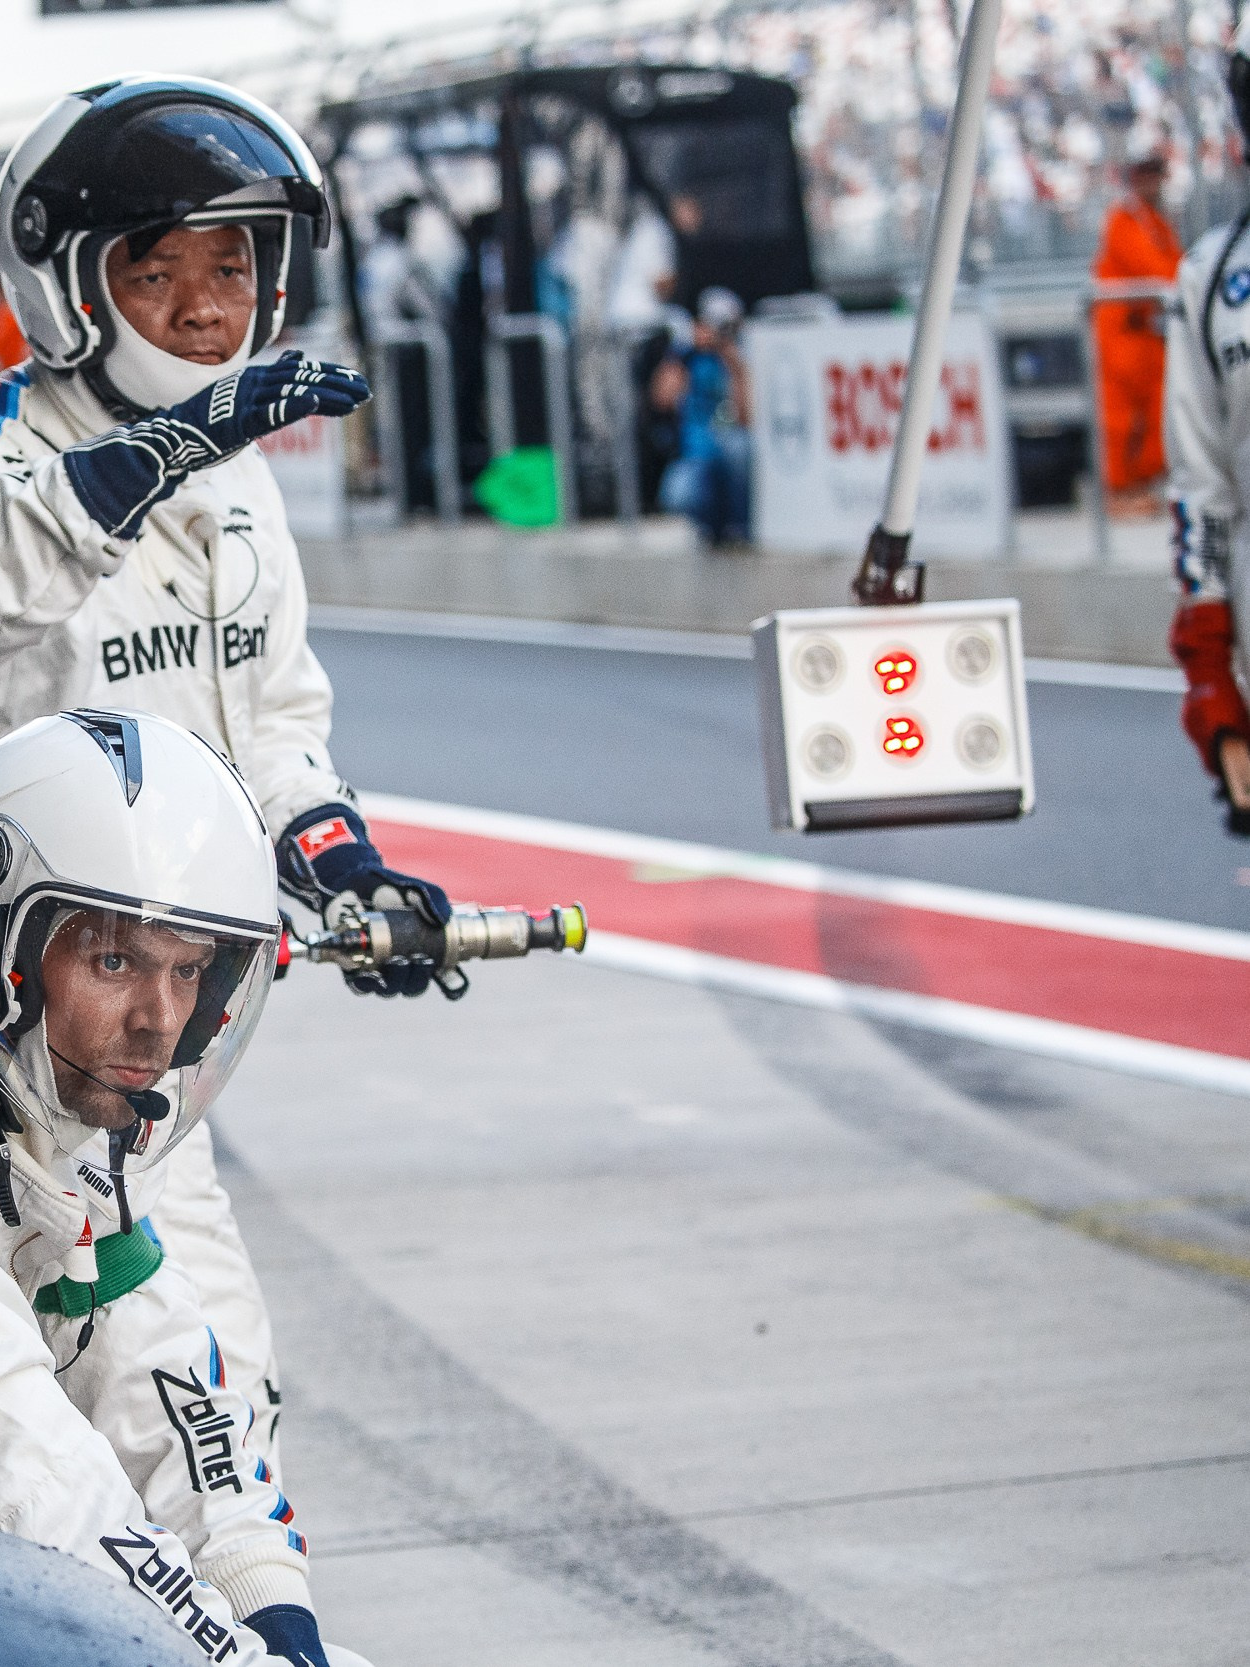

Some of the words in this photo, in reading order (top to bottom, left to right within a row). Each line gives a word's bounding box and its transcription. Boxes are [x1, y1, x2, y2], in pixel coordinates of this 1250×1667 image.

[824, 358, 987, 456] BOSH
[102, 624, 199, 682] BMW
[77, 1164, 113, 1198] PUMA
[151, 1366, 243, 1493] Zollner
[99, 1526, 238, 1663] Zollner
